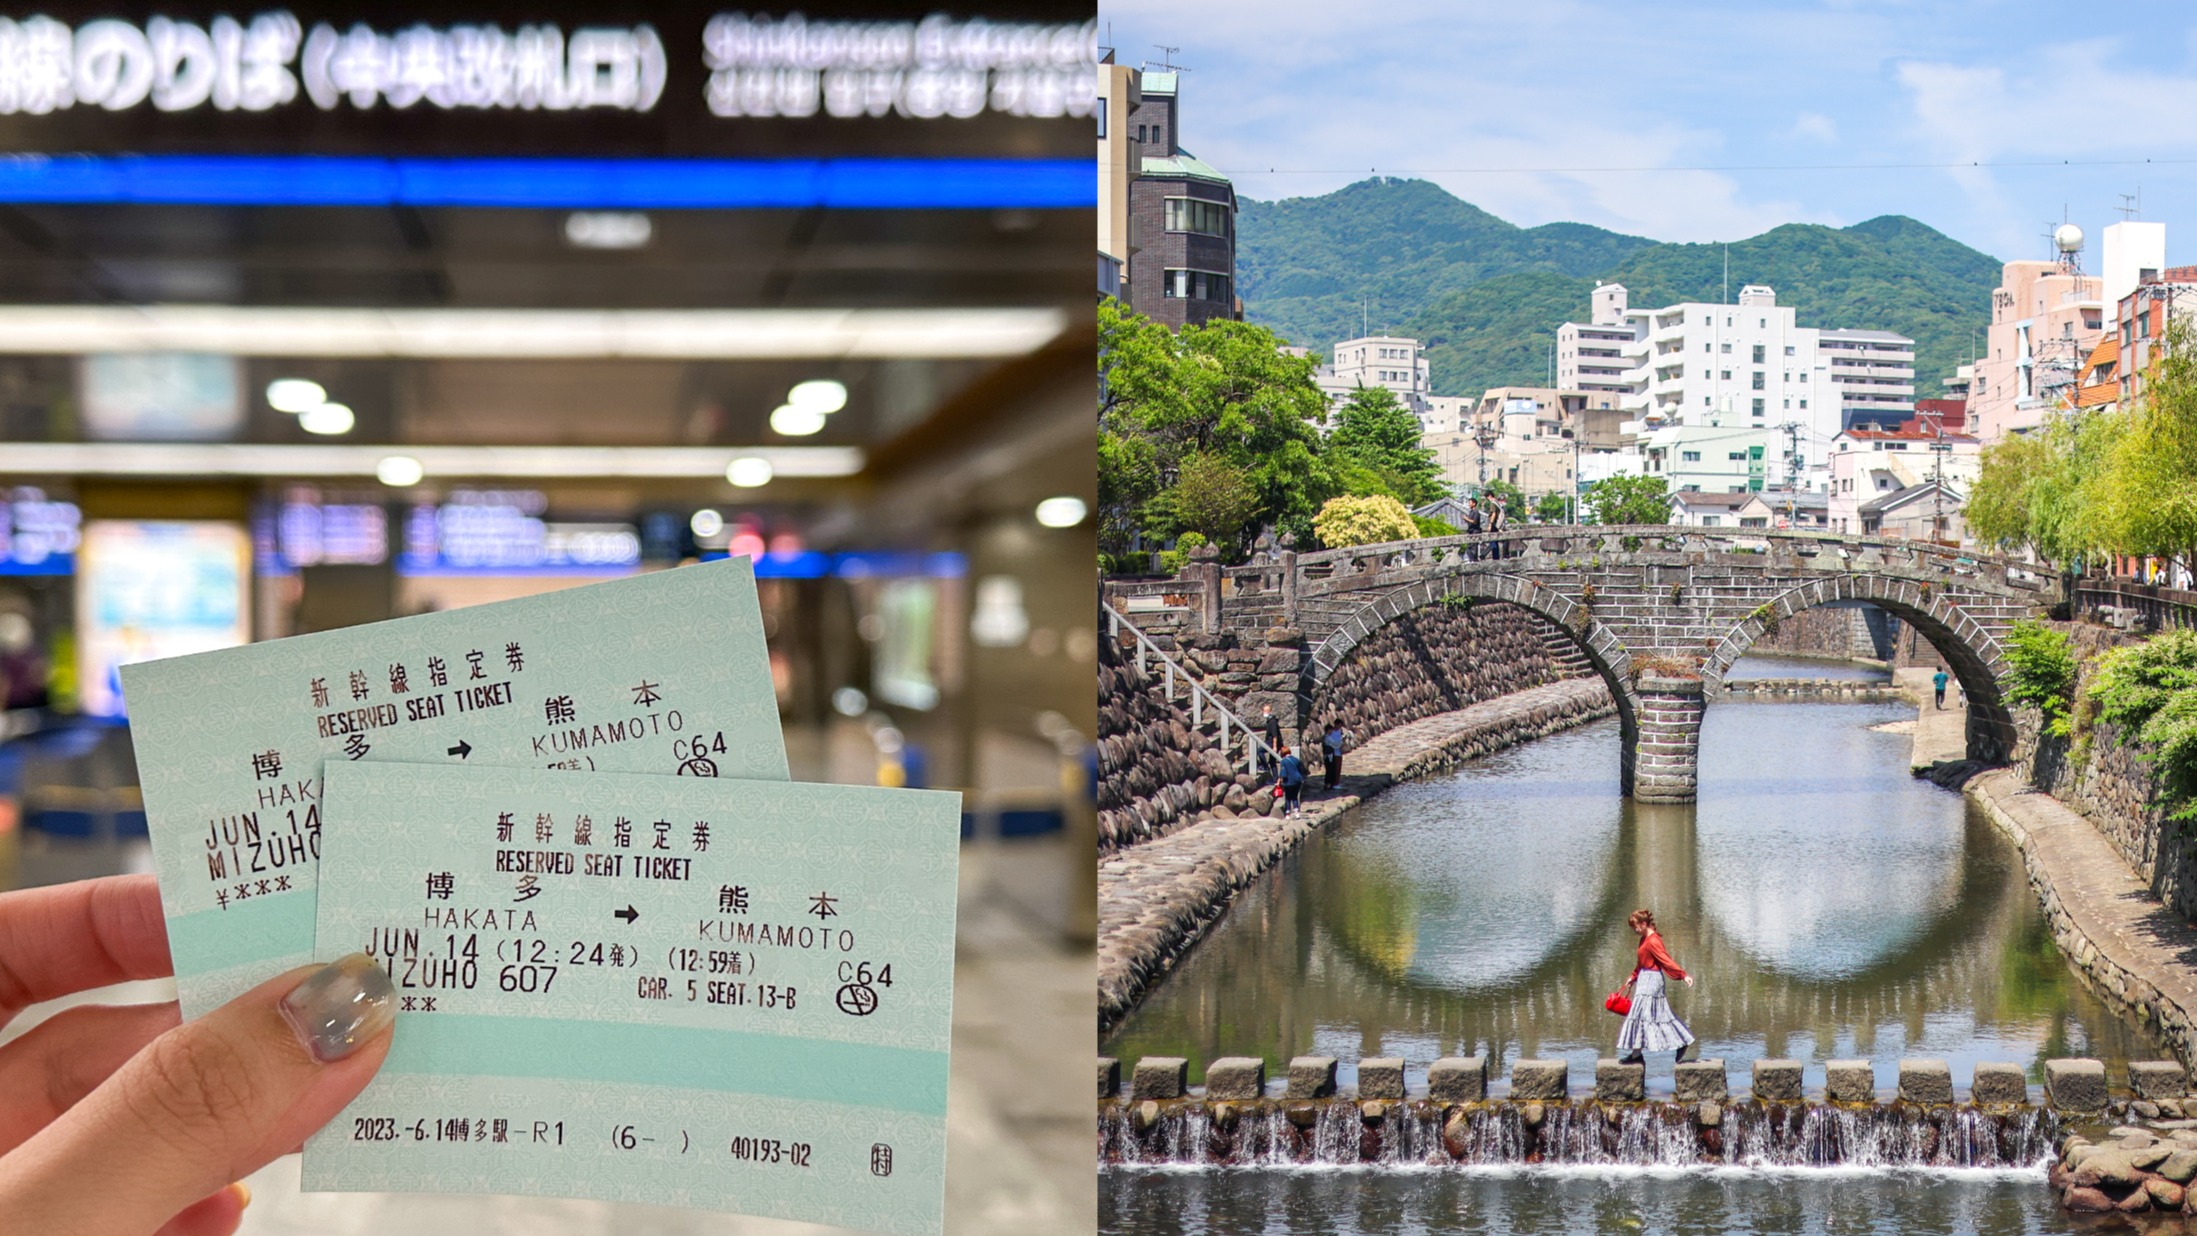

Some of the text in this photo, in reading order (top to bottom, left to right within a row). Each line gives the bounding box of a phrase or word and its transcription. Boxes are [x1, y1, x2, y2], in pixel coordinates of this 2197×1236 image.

[311, 642, 524, 708] 新幹線指定券
[317, 682, 513, 738] RESERVED SEAT TICKET
[532, 710, 683, 757] KUMAMOTO
[674, 731, 728, 761] C64
[257, 777, 324, 809] HAK
[496, 812, 710, 851] 新幹線指定券
[496, 850, 692, 880] RESERVED SEAT TICKET
[424, 907, 537, 932] HAKATA
[699, 919, 854, 952] KUMAMOTO
[375, 956, 557, 993] IZUHO 607
[637, 976, 673, 1001] CAR.
[687, 979, 697, 1002] 5
[837, 961, 893, 988] C64
[731, 1136, 811, 1167] 40193-02
